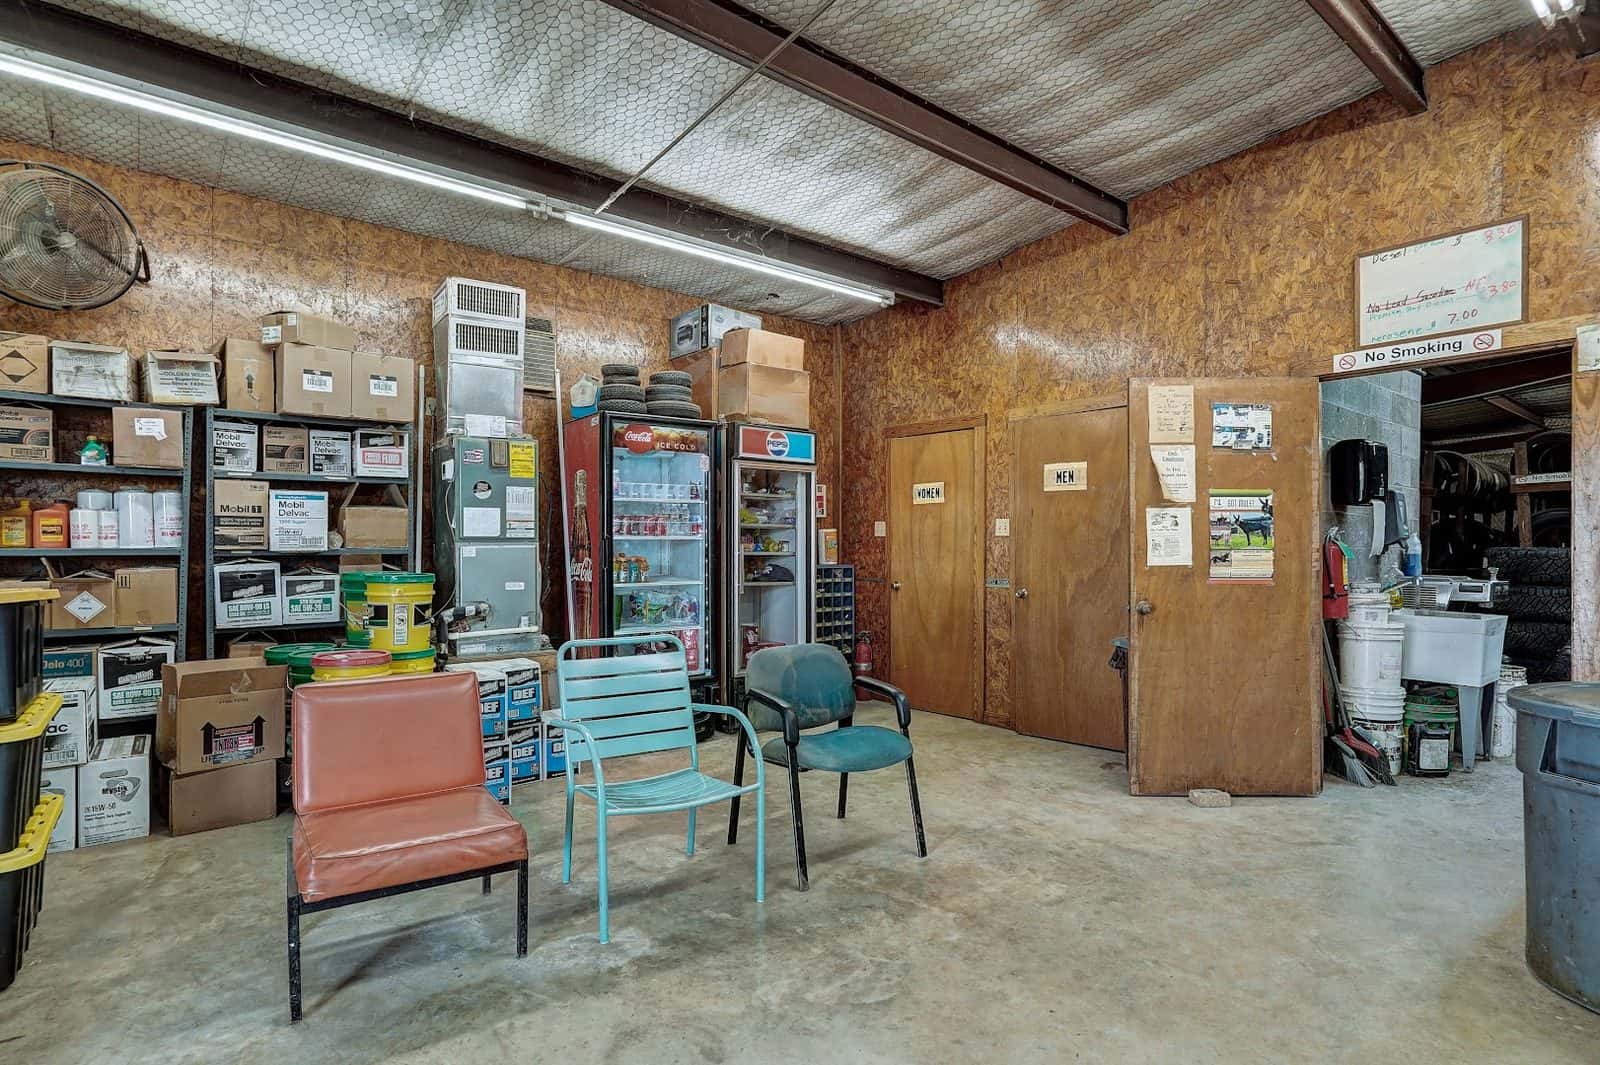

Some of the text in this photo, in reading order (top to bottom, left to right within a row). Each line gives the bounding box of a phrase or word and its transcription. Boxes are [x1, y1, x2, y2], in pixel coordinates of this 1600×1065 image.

[1364, 340, 1463, 363] No Smoking
[215, 432, 241, 441] Mobil
[624, 430, 653, 443] Coca-Cola
[215, 439, 247, 448] Delvac
[313, 440, 337, 448] Mobil
[655, 441, 696, 450] ICE COLD
[767, 439, 788, 449] PEPSI
[1055, 469, 1075, 484] MEN
[917, 487, 941, 499] WOMEN
[219, 504, 250, 514] Mobil
[278, 500, 305, 509] Mobil
[278, 508, 310, 518] Delvac
[66, 658, 85, 668] 400
[513, 688, 536, 701] DEF
[480, 701, 499, 713] EF
[512, 746, 535, 759] DEF
[486, 767, 503, 780] EF
